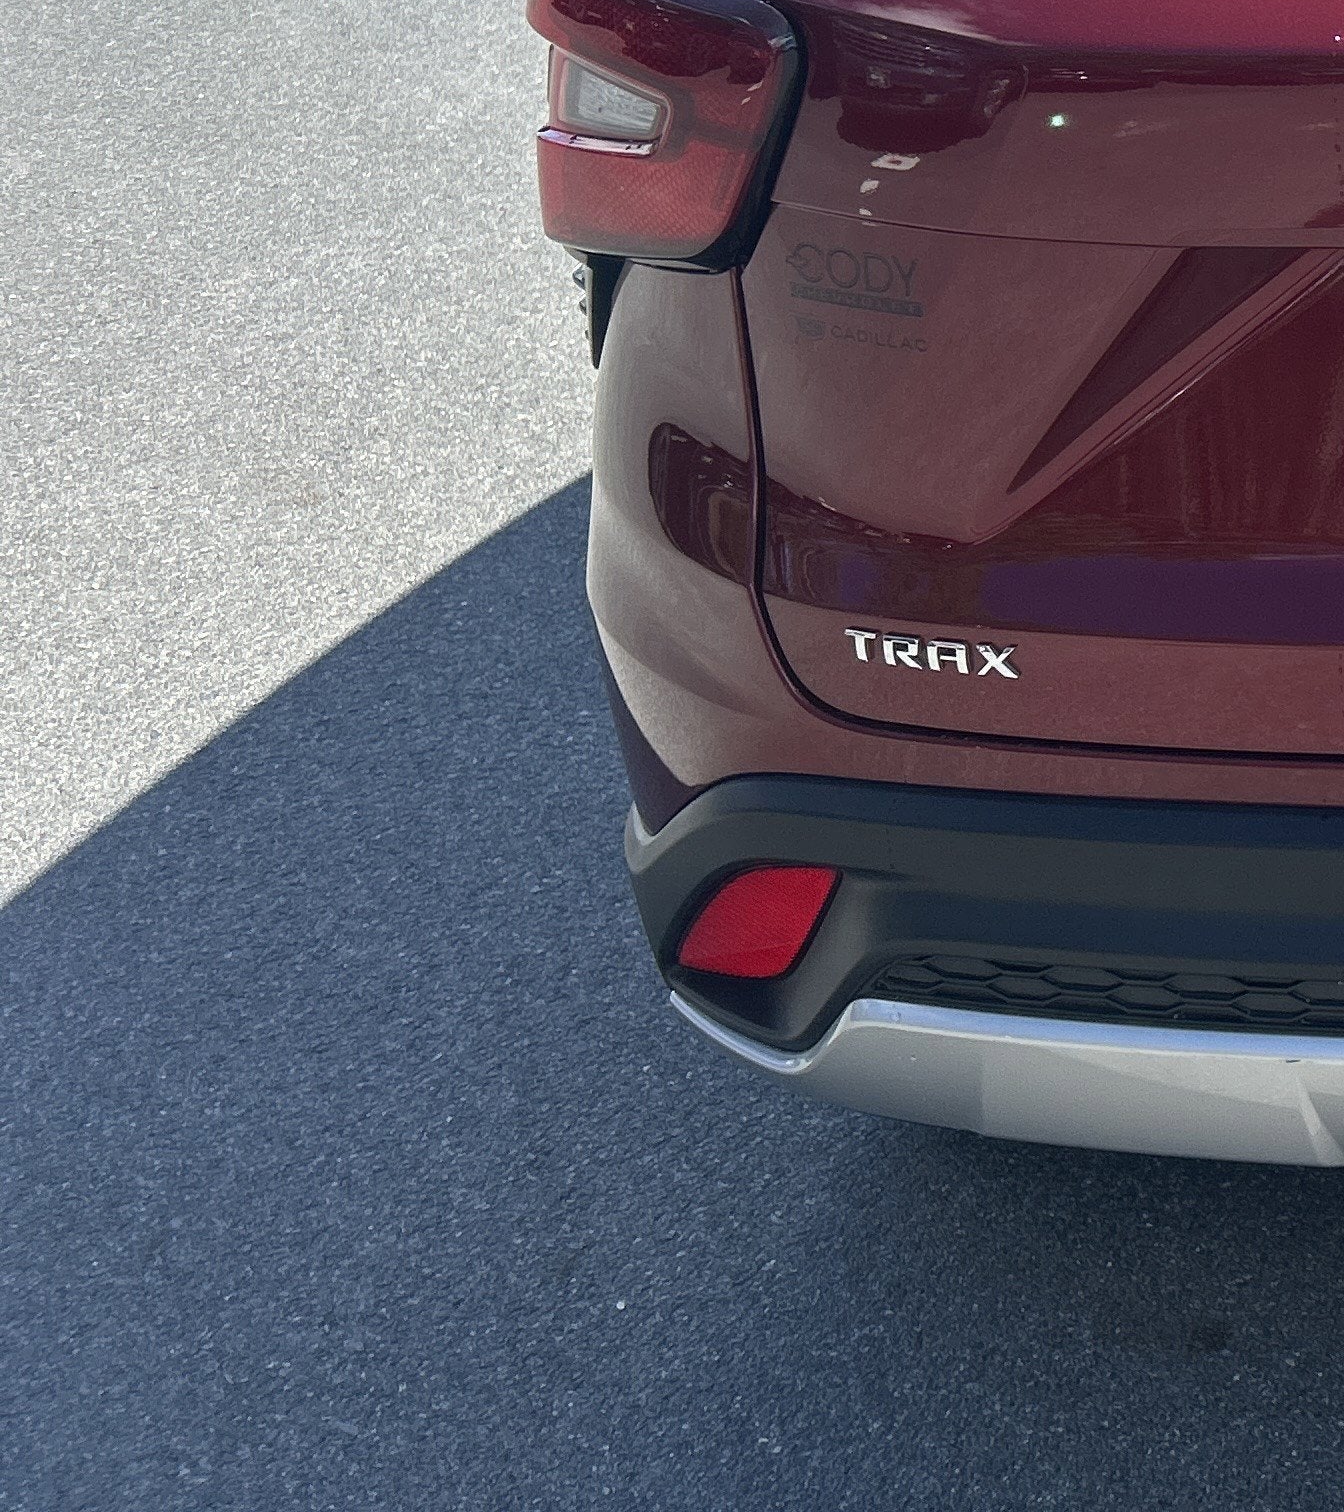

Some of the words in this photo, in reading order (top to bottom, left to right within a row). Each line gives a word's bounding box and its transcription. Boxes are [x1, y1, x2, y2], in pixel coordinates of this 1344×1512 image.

[786, 242, 919, 296] CODY
[830, 324, 928, 353] CADILLAC
[844, 627, 1020, 679] TRAX
